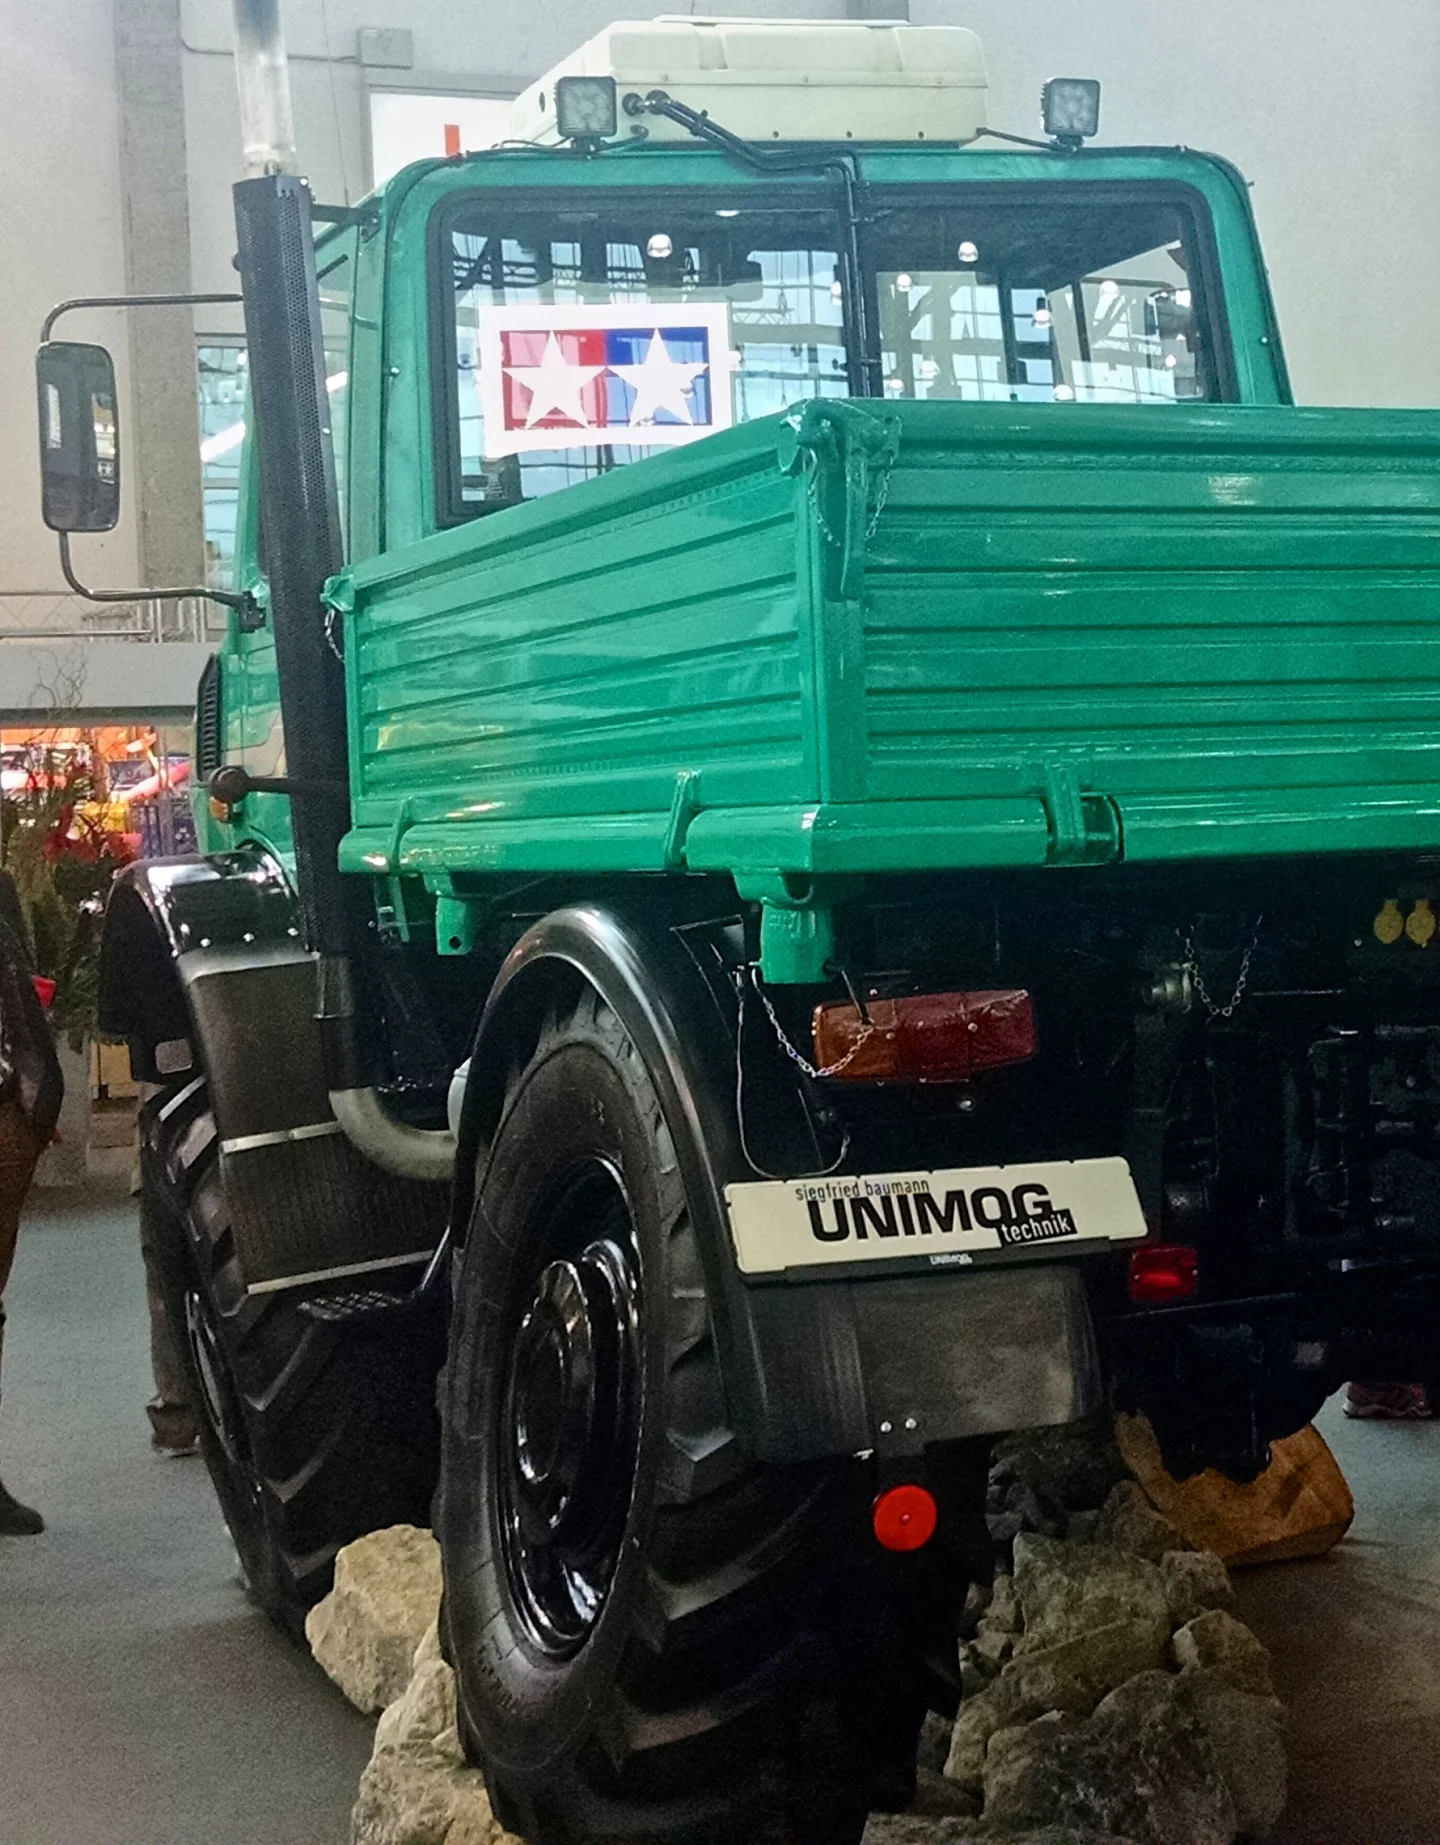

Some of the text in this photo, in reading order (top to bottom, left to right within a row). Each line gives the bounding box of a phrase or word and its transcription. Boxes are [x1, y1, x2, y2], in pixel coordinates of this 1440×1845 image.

[795, 1179, 931, 1204] siegfried baumann
[806, 1183, 1053, 1243] UNIMOG
[1000, 1215, 1072, 1245] technik
